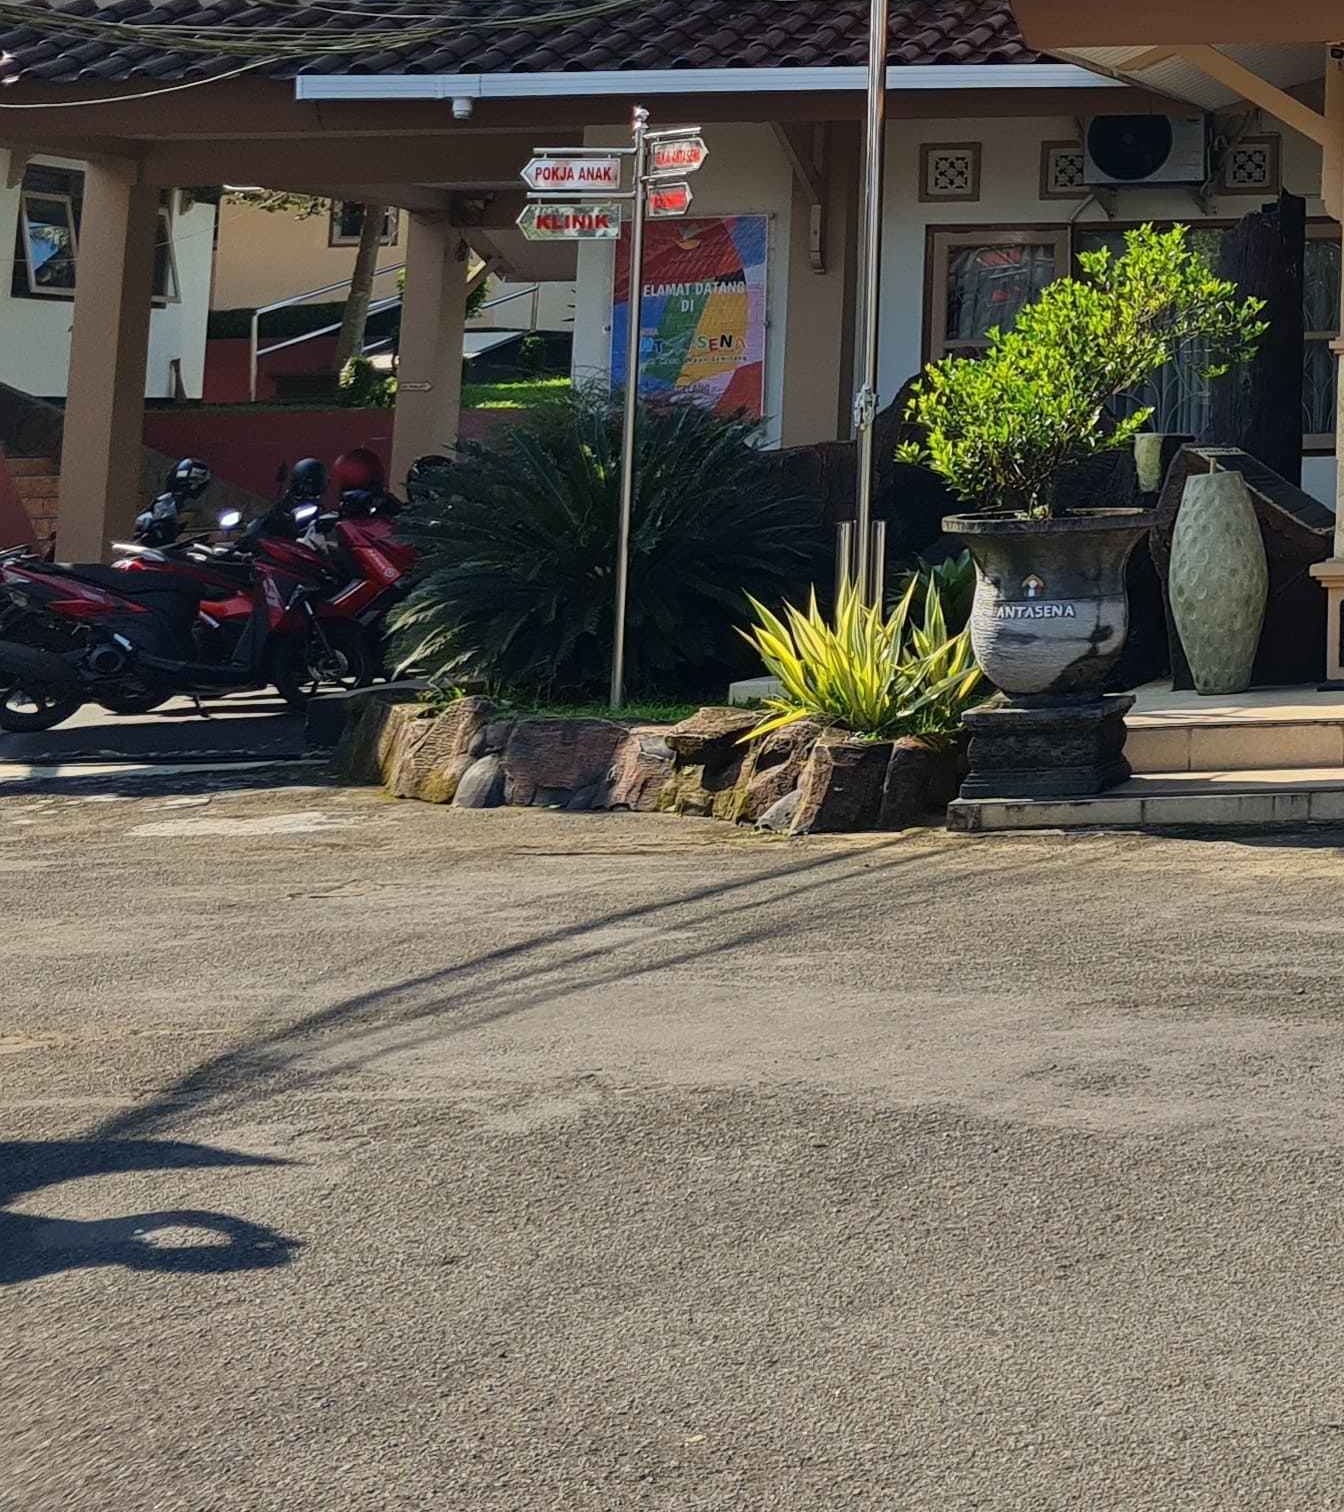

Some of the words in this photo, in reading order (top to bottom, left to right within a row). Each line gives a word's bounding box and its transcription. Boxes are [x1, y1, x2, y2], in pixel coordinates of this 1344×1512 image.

[535, 167, 574, 181] POKJA
[578, 167, 612, 181] ANAK
[536, 214, 609, 229] KLINIK
[643, 283, 691, 297] ELAMAT
[695, 282, 745, 295] DATANG
[681, 300, 694, 312] DI
[997, 604, 1075, 619] ANTASENA
